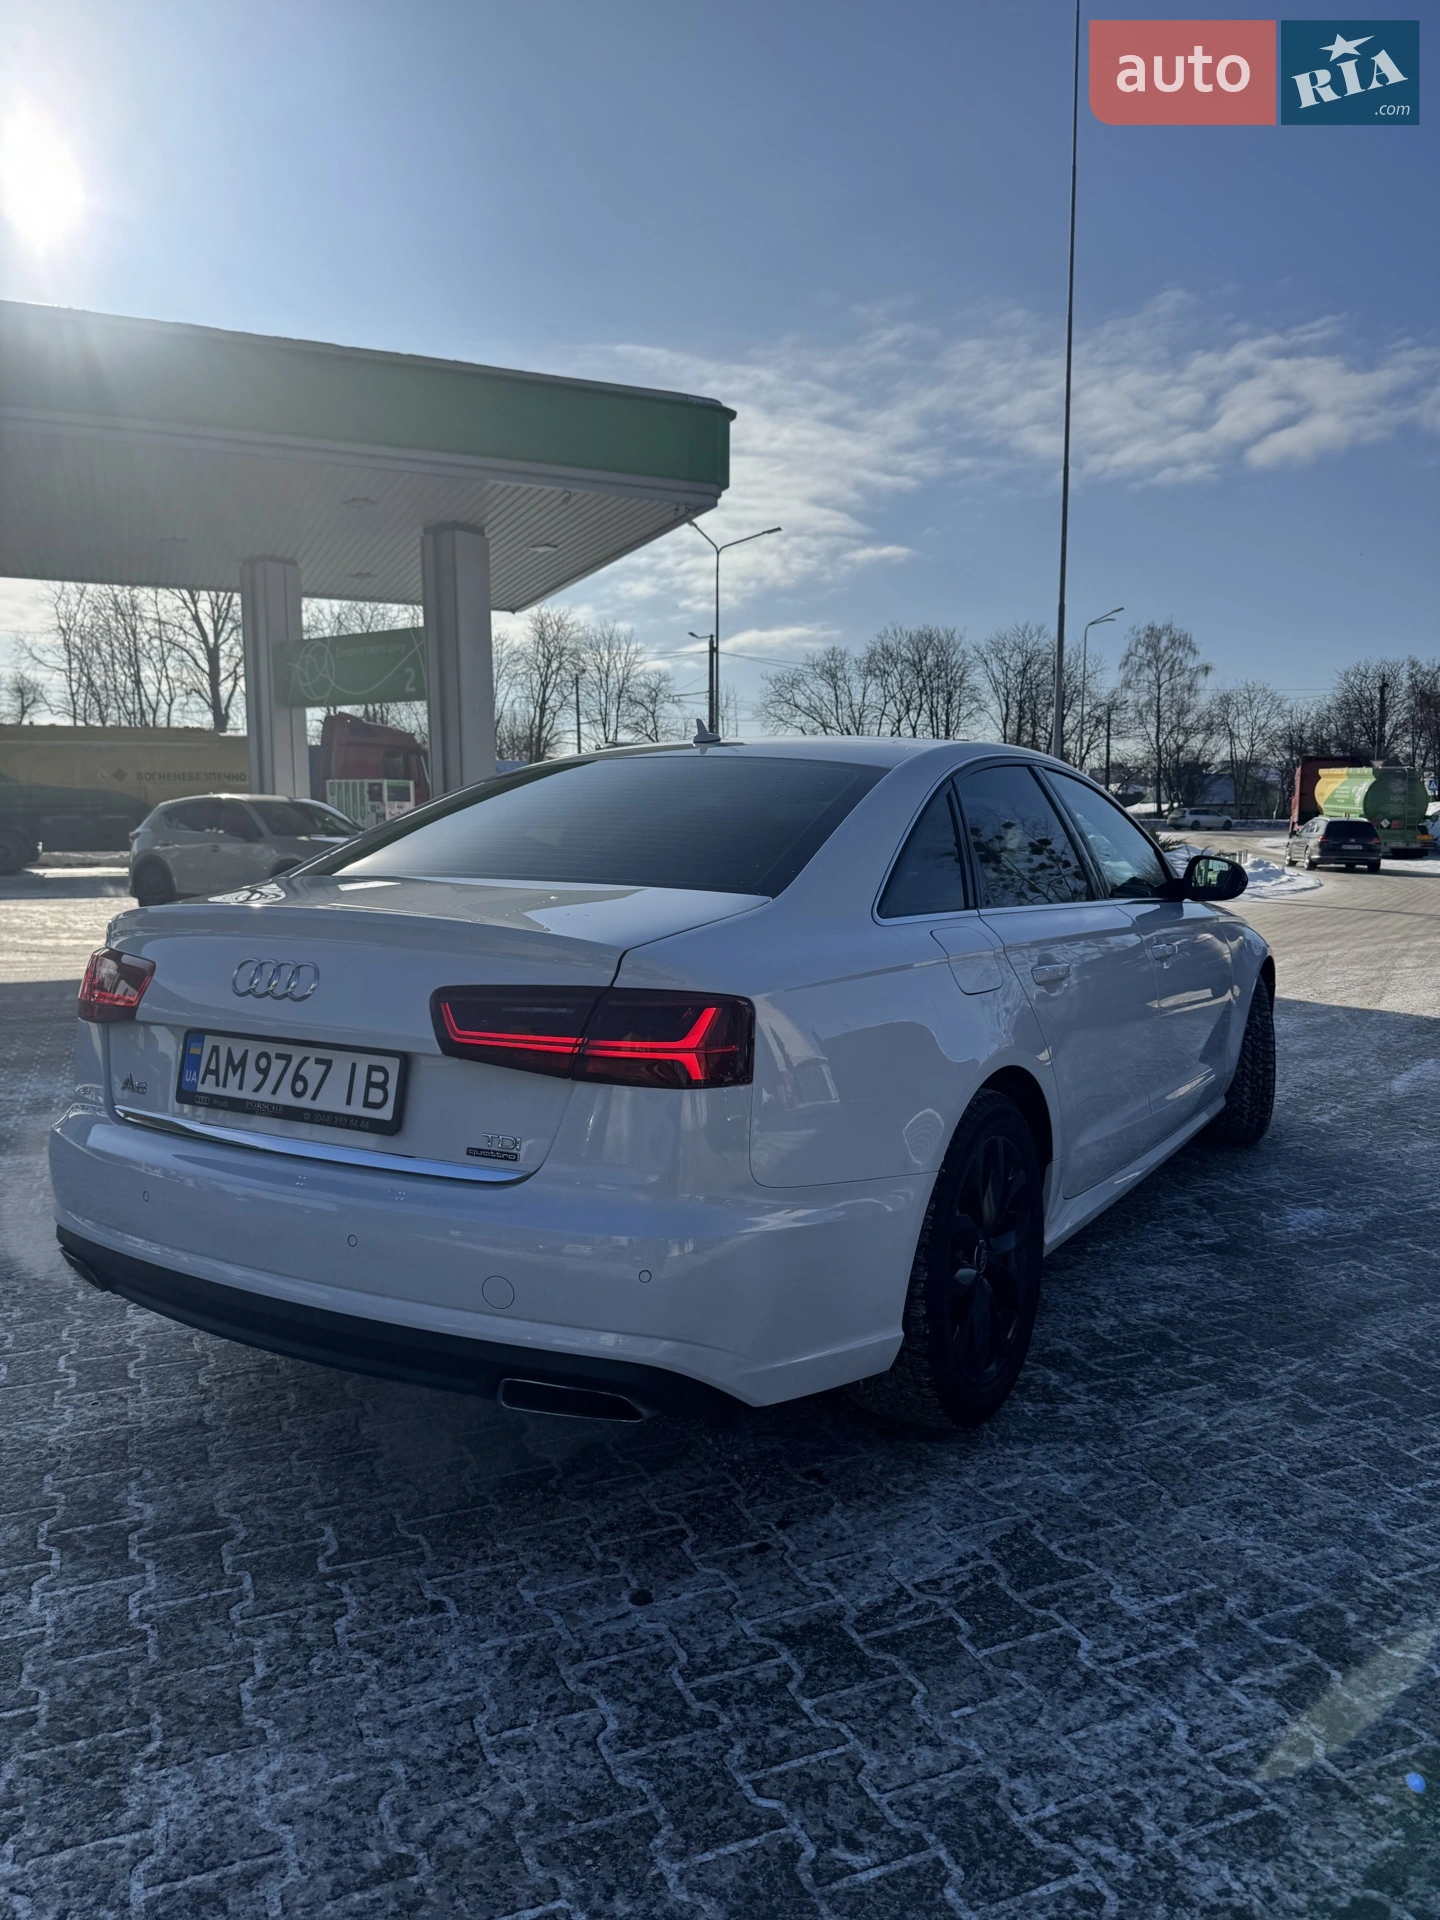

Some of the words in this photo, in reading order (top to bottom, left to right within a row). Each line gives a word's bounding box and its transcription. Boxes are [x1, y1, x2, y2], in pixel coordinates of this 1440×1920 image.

[404, 667, 416, 692] 2
[136, 771, 247, 782] ВОГНЕНЕБЕЗПЕЧНО
[185, 1069, 197, 1083] UA
[252, 1051, 333, 1101] 9767
[345, 1062, 390, 1110] IB
[246, 1100, 285, 1113] PORSCHE
[482, 1132, 521, 1151] TDI
[467, 1148, 517, 1160] quattro
